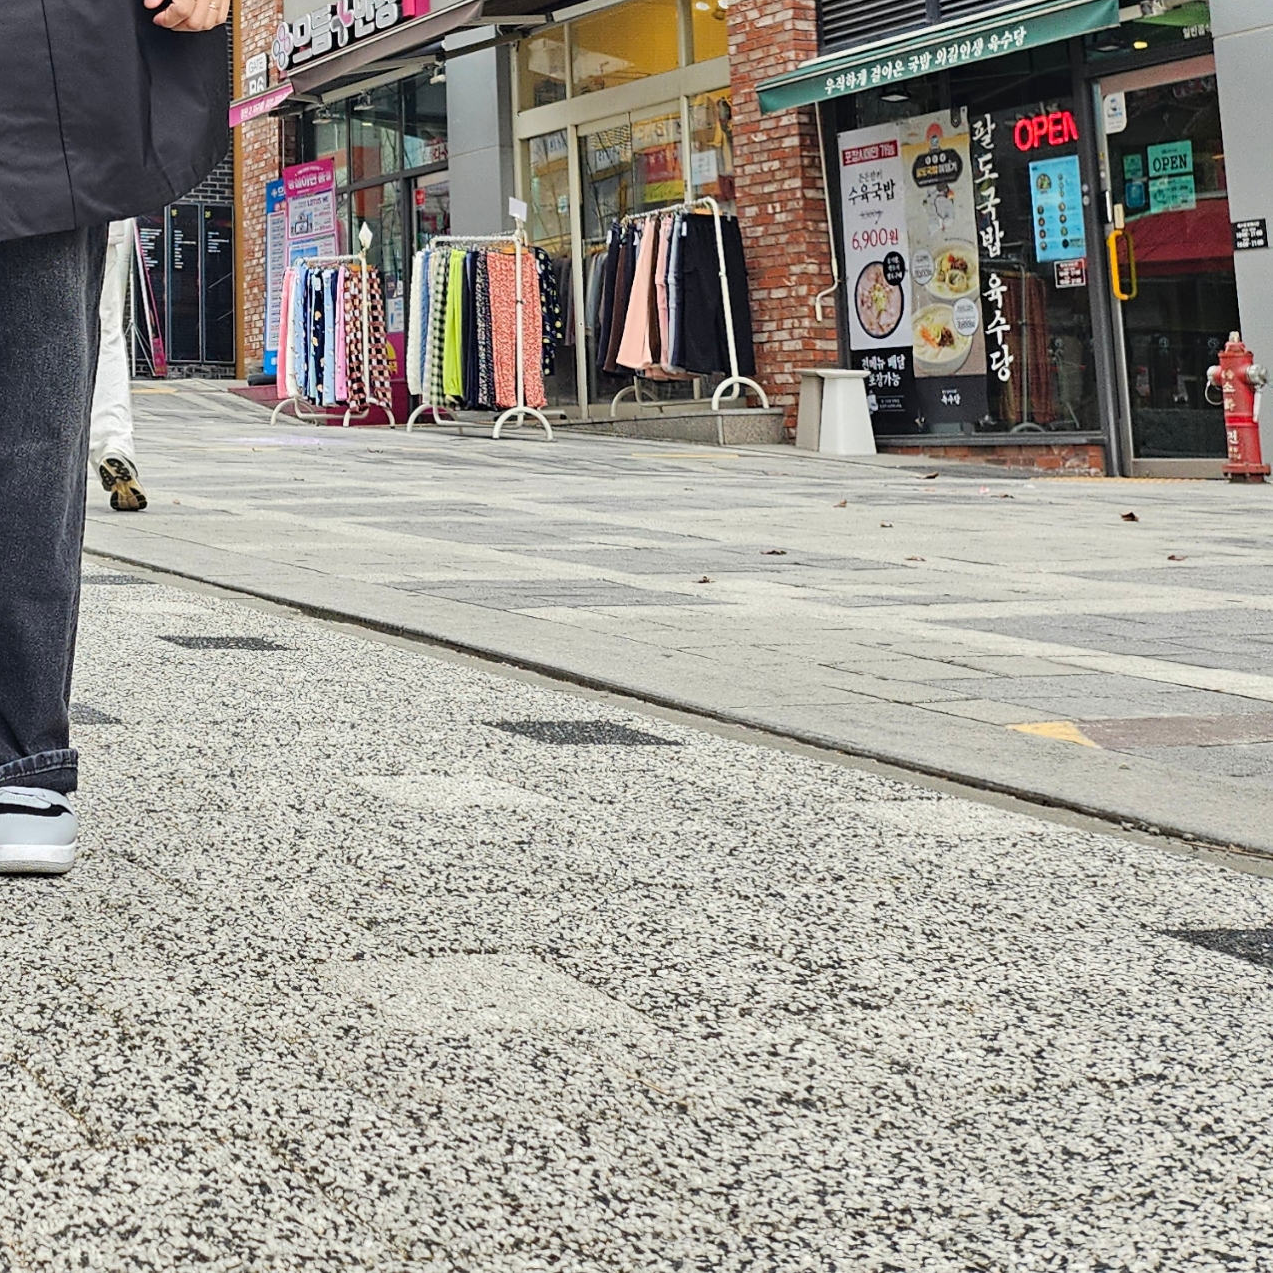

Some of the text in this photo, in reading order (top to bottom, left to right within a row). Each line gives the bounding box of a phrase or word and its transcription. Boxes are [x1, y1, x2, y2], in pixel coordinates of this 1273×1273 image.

[907, 51, 932, 73] 국밥
[987, 26, 1027, 53] 육수당
[249, 57, 264, 74] GATE
[1013, 111, 1079, 152] OPEN
[1152, 153, 1188, 173] OPEN
[848, 178, 896, 206] 수육국밥
[852, 227, 899, 252] 6,900원
[972, 113, 1015, 382] 팔도국밥 육수당
[887, 353, 906, 370] 배달
[868, 371, 902, 387] 포장가능
